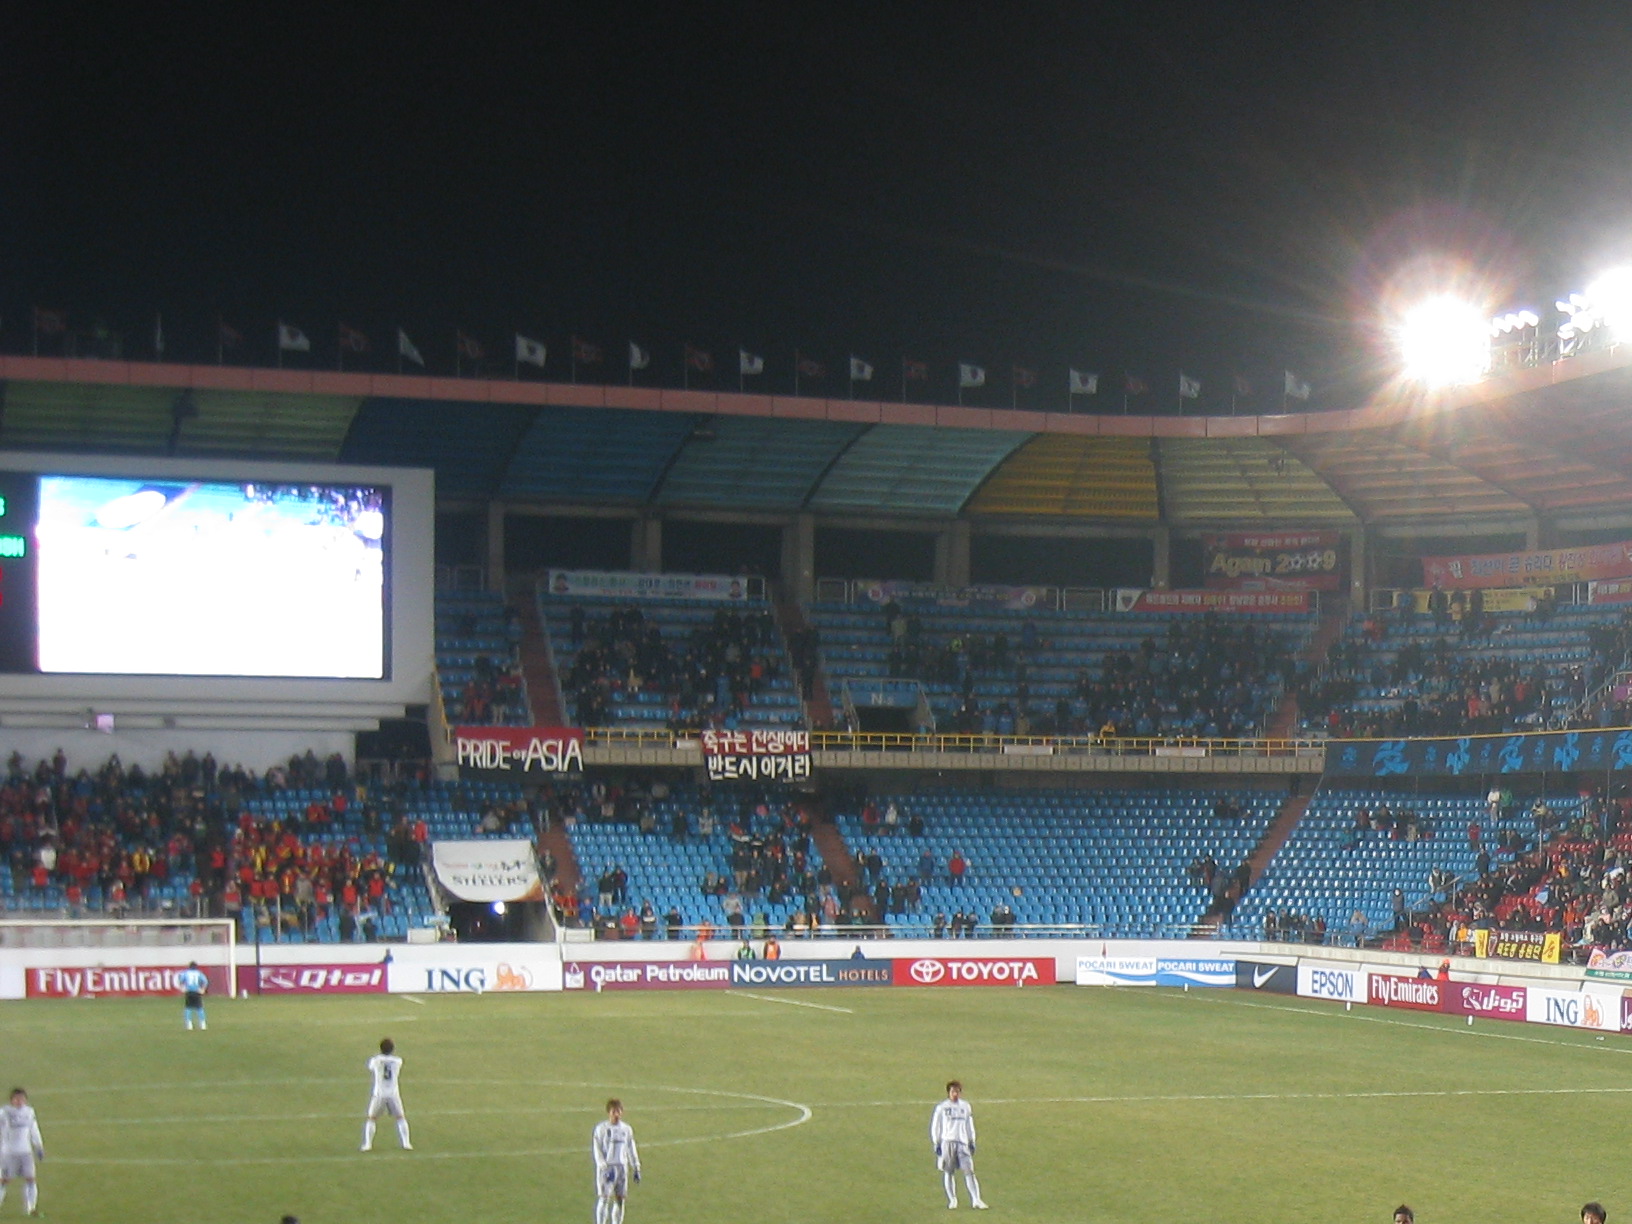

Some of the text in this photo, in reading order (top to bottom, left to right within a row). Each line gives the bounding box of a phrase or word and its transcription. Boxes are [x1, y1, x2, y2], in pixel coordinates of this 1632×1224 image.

[703, 729, 747, 753] 축구는
[457, 737, 511, 770] PRIDE
[523, 737, 584, 772] ASIA
[708, 754, 757, 780] 반드시
[590, 963, 729, 984] Qatar Petroleum
[733, 963, 889, 983] NOVOTEL HOTELS
[947, 961, 1039, 980] TOYOTA
[1078, 960, 1154, 971] POCARI SWEAT
[1157, 961, 1235, 972] POCARI SWEAT
[38, 967, 80, 997] Fly
[426, 967, 487, 992] ING
[1311, 969, 1354, 998] EPSON
[1371, 974, 1439, 1005] Fly Emirates
[1545, 996, 1579, 1025] ING
